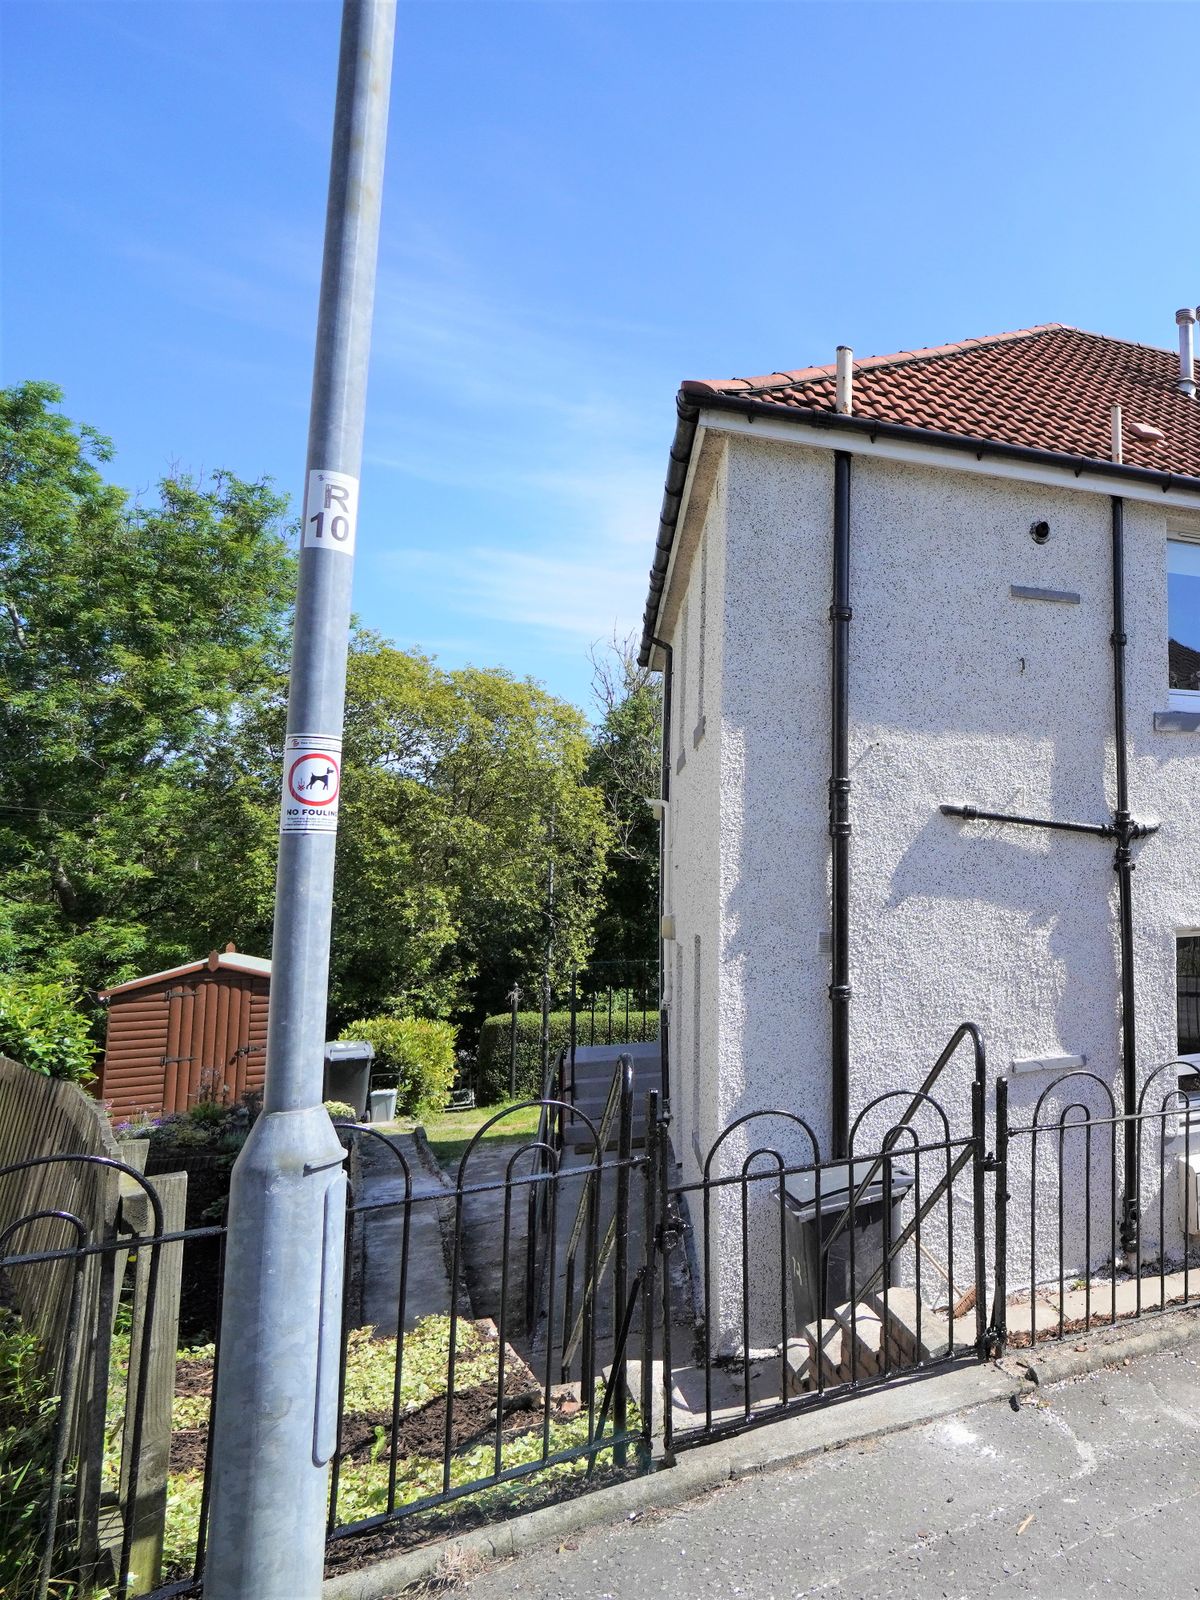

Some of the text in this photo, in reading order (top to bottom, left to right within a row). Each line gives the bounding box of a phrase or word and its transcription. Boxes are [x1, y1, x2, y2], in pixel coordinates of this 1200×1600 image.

[324, 484, 350, 513] R
[310, 511, 350, 542] 10
[286, 808, 299, 816] NO
